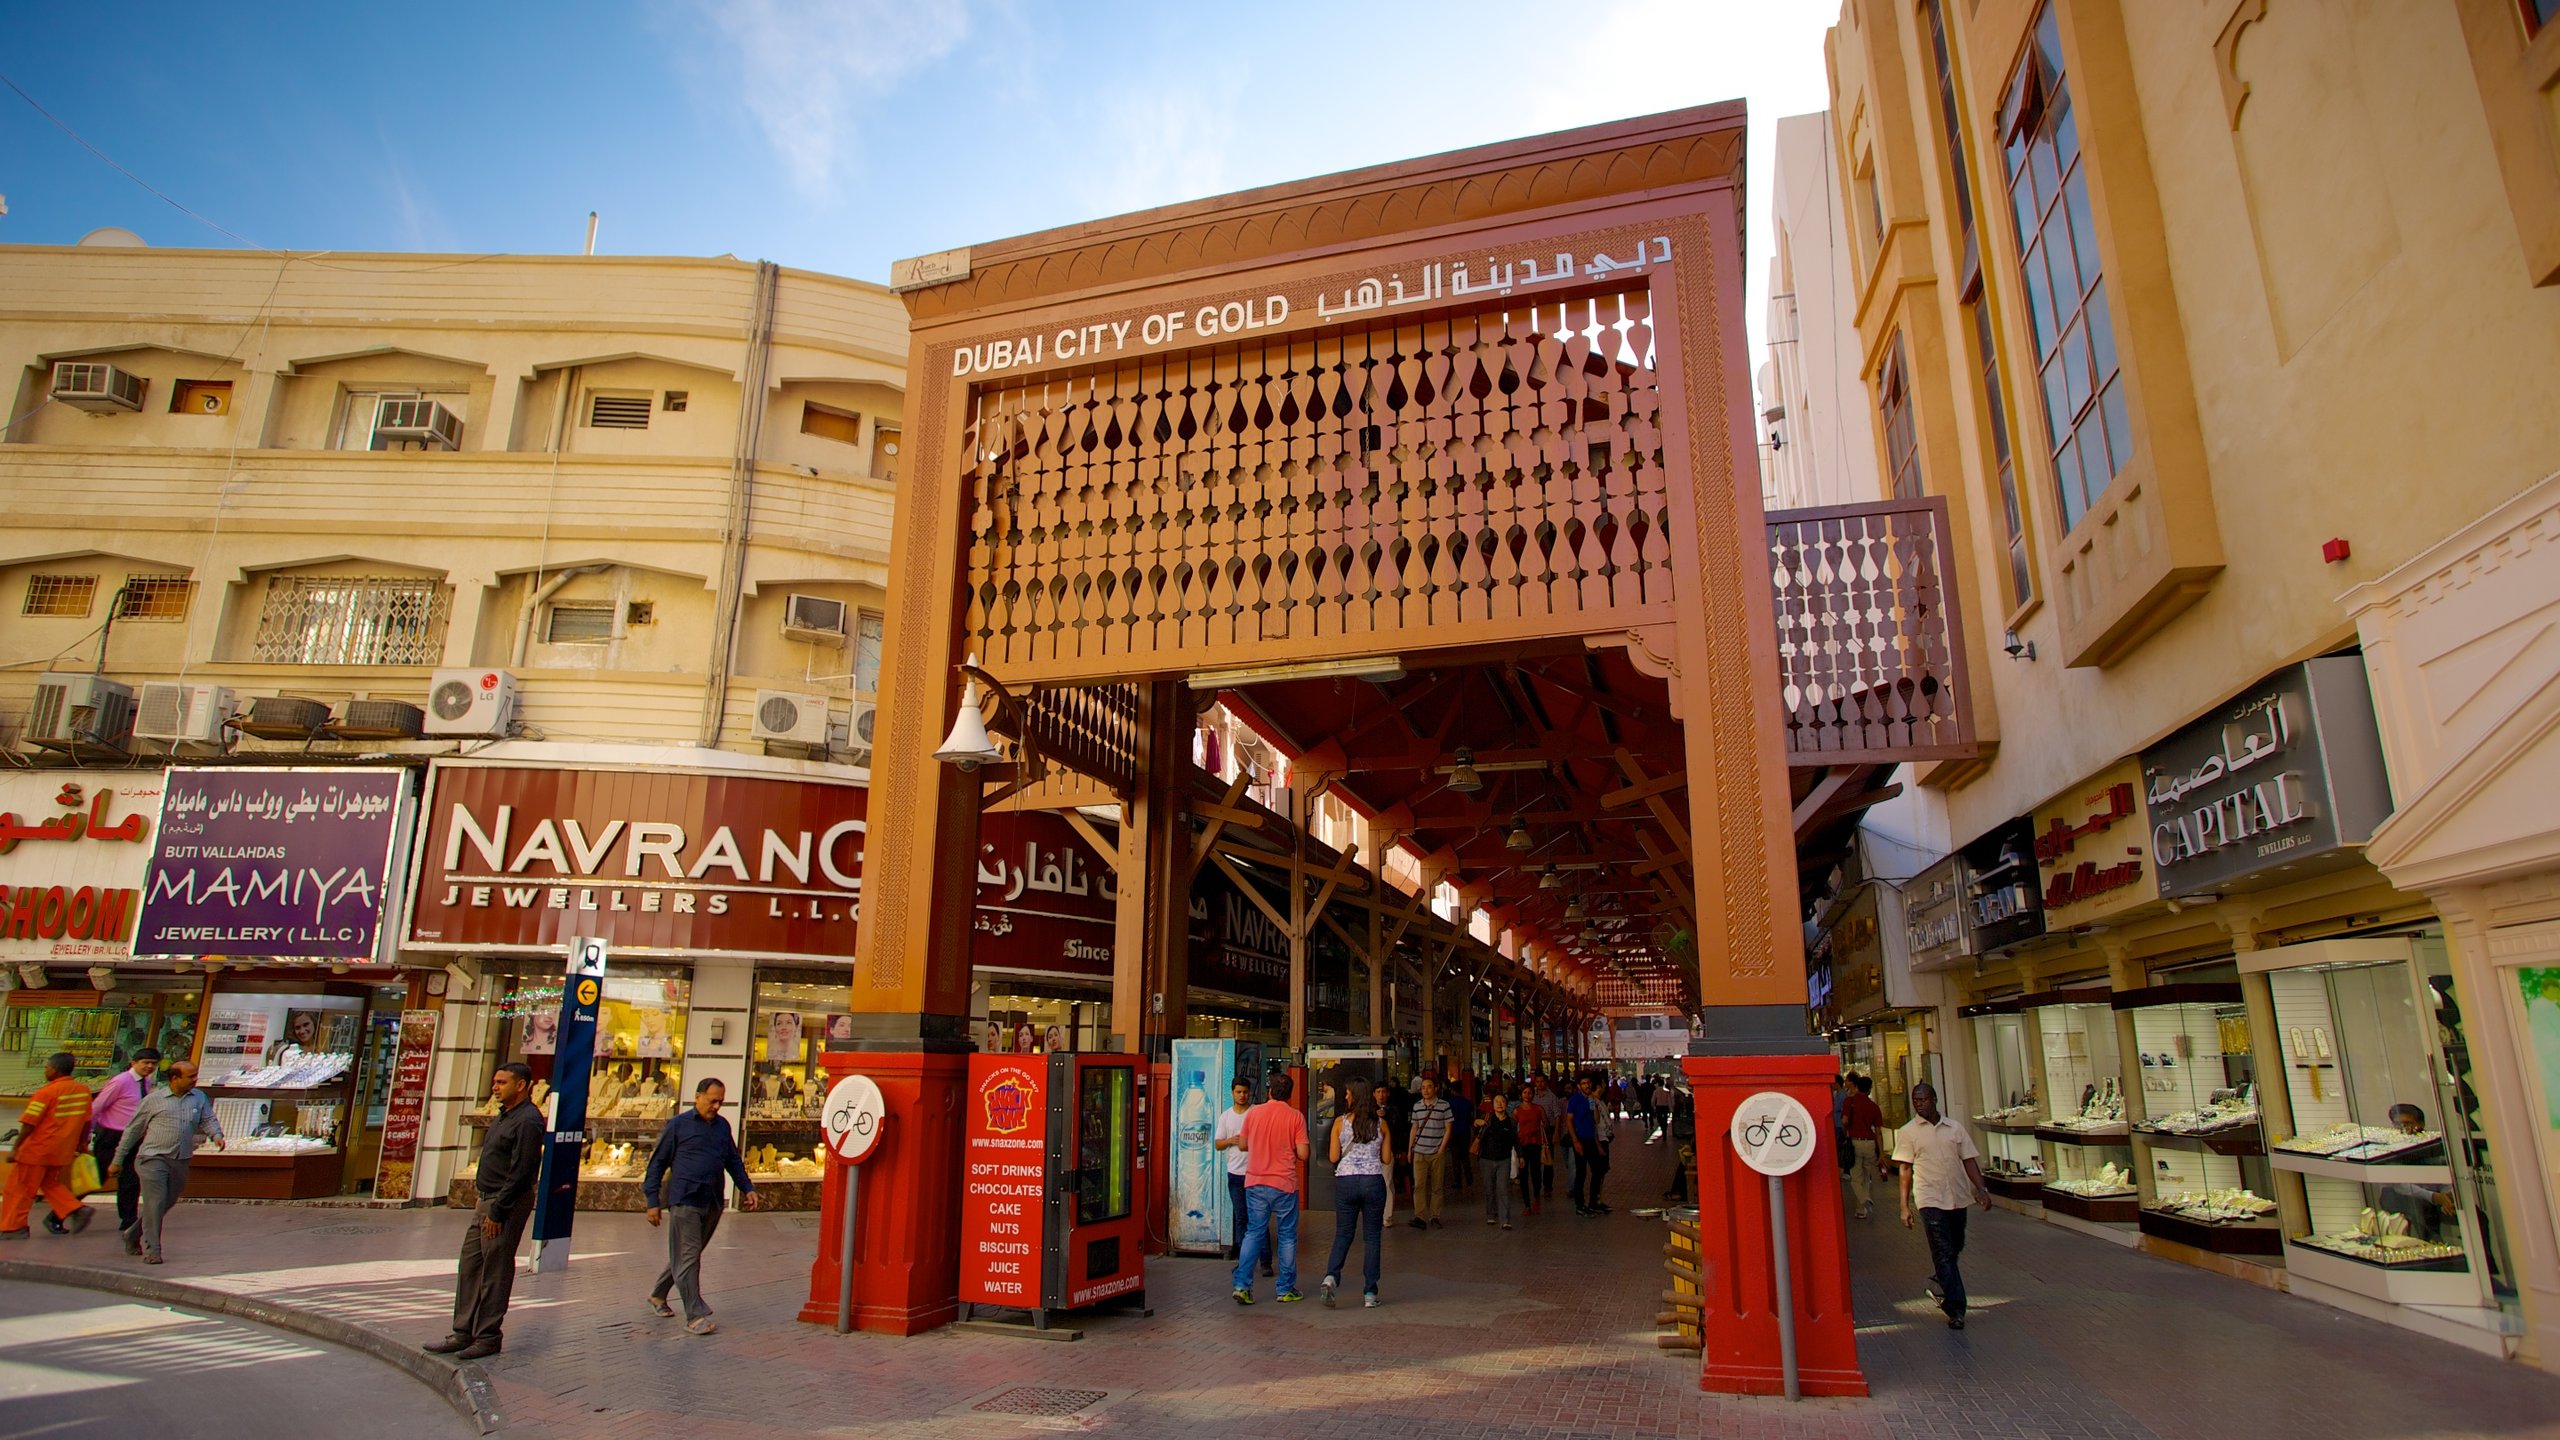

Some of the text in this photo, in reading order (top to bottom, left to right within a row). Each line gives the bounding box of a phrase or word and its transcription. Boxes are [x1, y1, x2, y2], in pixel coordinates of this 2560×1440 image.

[1318, 236, 1672, 323] دبي مدينة الذهب
[953, 295, 1289, 377] DUBAI CITY OF GOLD
[479, 692, 494, 701] LG
[2145, 695, 2290, 805] العاصمة
[120, 787, 161, 797] مجوهرات
[209, 790, 241, 819] داس
[285, 788, 319, 823] بطي
[323, 786, 390, 821] مجوهرات
[2153, 772, 2304, 867] CAPITAL
[165, 846, 286, 859] BUTI VALLAHDAS
[443, 803, 866, 888] NAVRANG
[2257, 835, 2296, 858] JEWELLERS
[147, 866, 375, 925] MAMIYA
[441, 885, 729, 915] JEWELLERS
[154, 927, 283, 942] JEWELLERY
[50, 944, 92, 955] JEWELLERY
[1063, 939, 1110, 961] Since
[1224, 953, 1288, 978] JEWELLERS
[979, 1070, 1000, 1093] SNACKS
[1010, 1067, 1021, 1075] THE
[1021, 1072, 1031, 1080] GO
[394, 1097, 419, 1106] WE BUY
[388, 1114, 406, 1122] GOLD
[971, 1138, 1043, 1149] www.snaxzone.com
[971, 1164, 1042, 1178] SOFT DRINKS
[970, 1183, 1043, 1197] CHOCOLATES
[989, 1203, 1021, 1216] CAKE
[990, 1222, 1019, 1235] NUTS
[979, 1242, 1029, 1255] BISCUITS
[988, 1261, 1020, 1275] JUICE
[984, 1281, 1022, 1294] WATER
[1073, 1274, 1140, 1304] www.snaxzone.com
